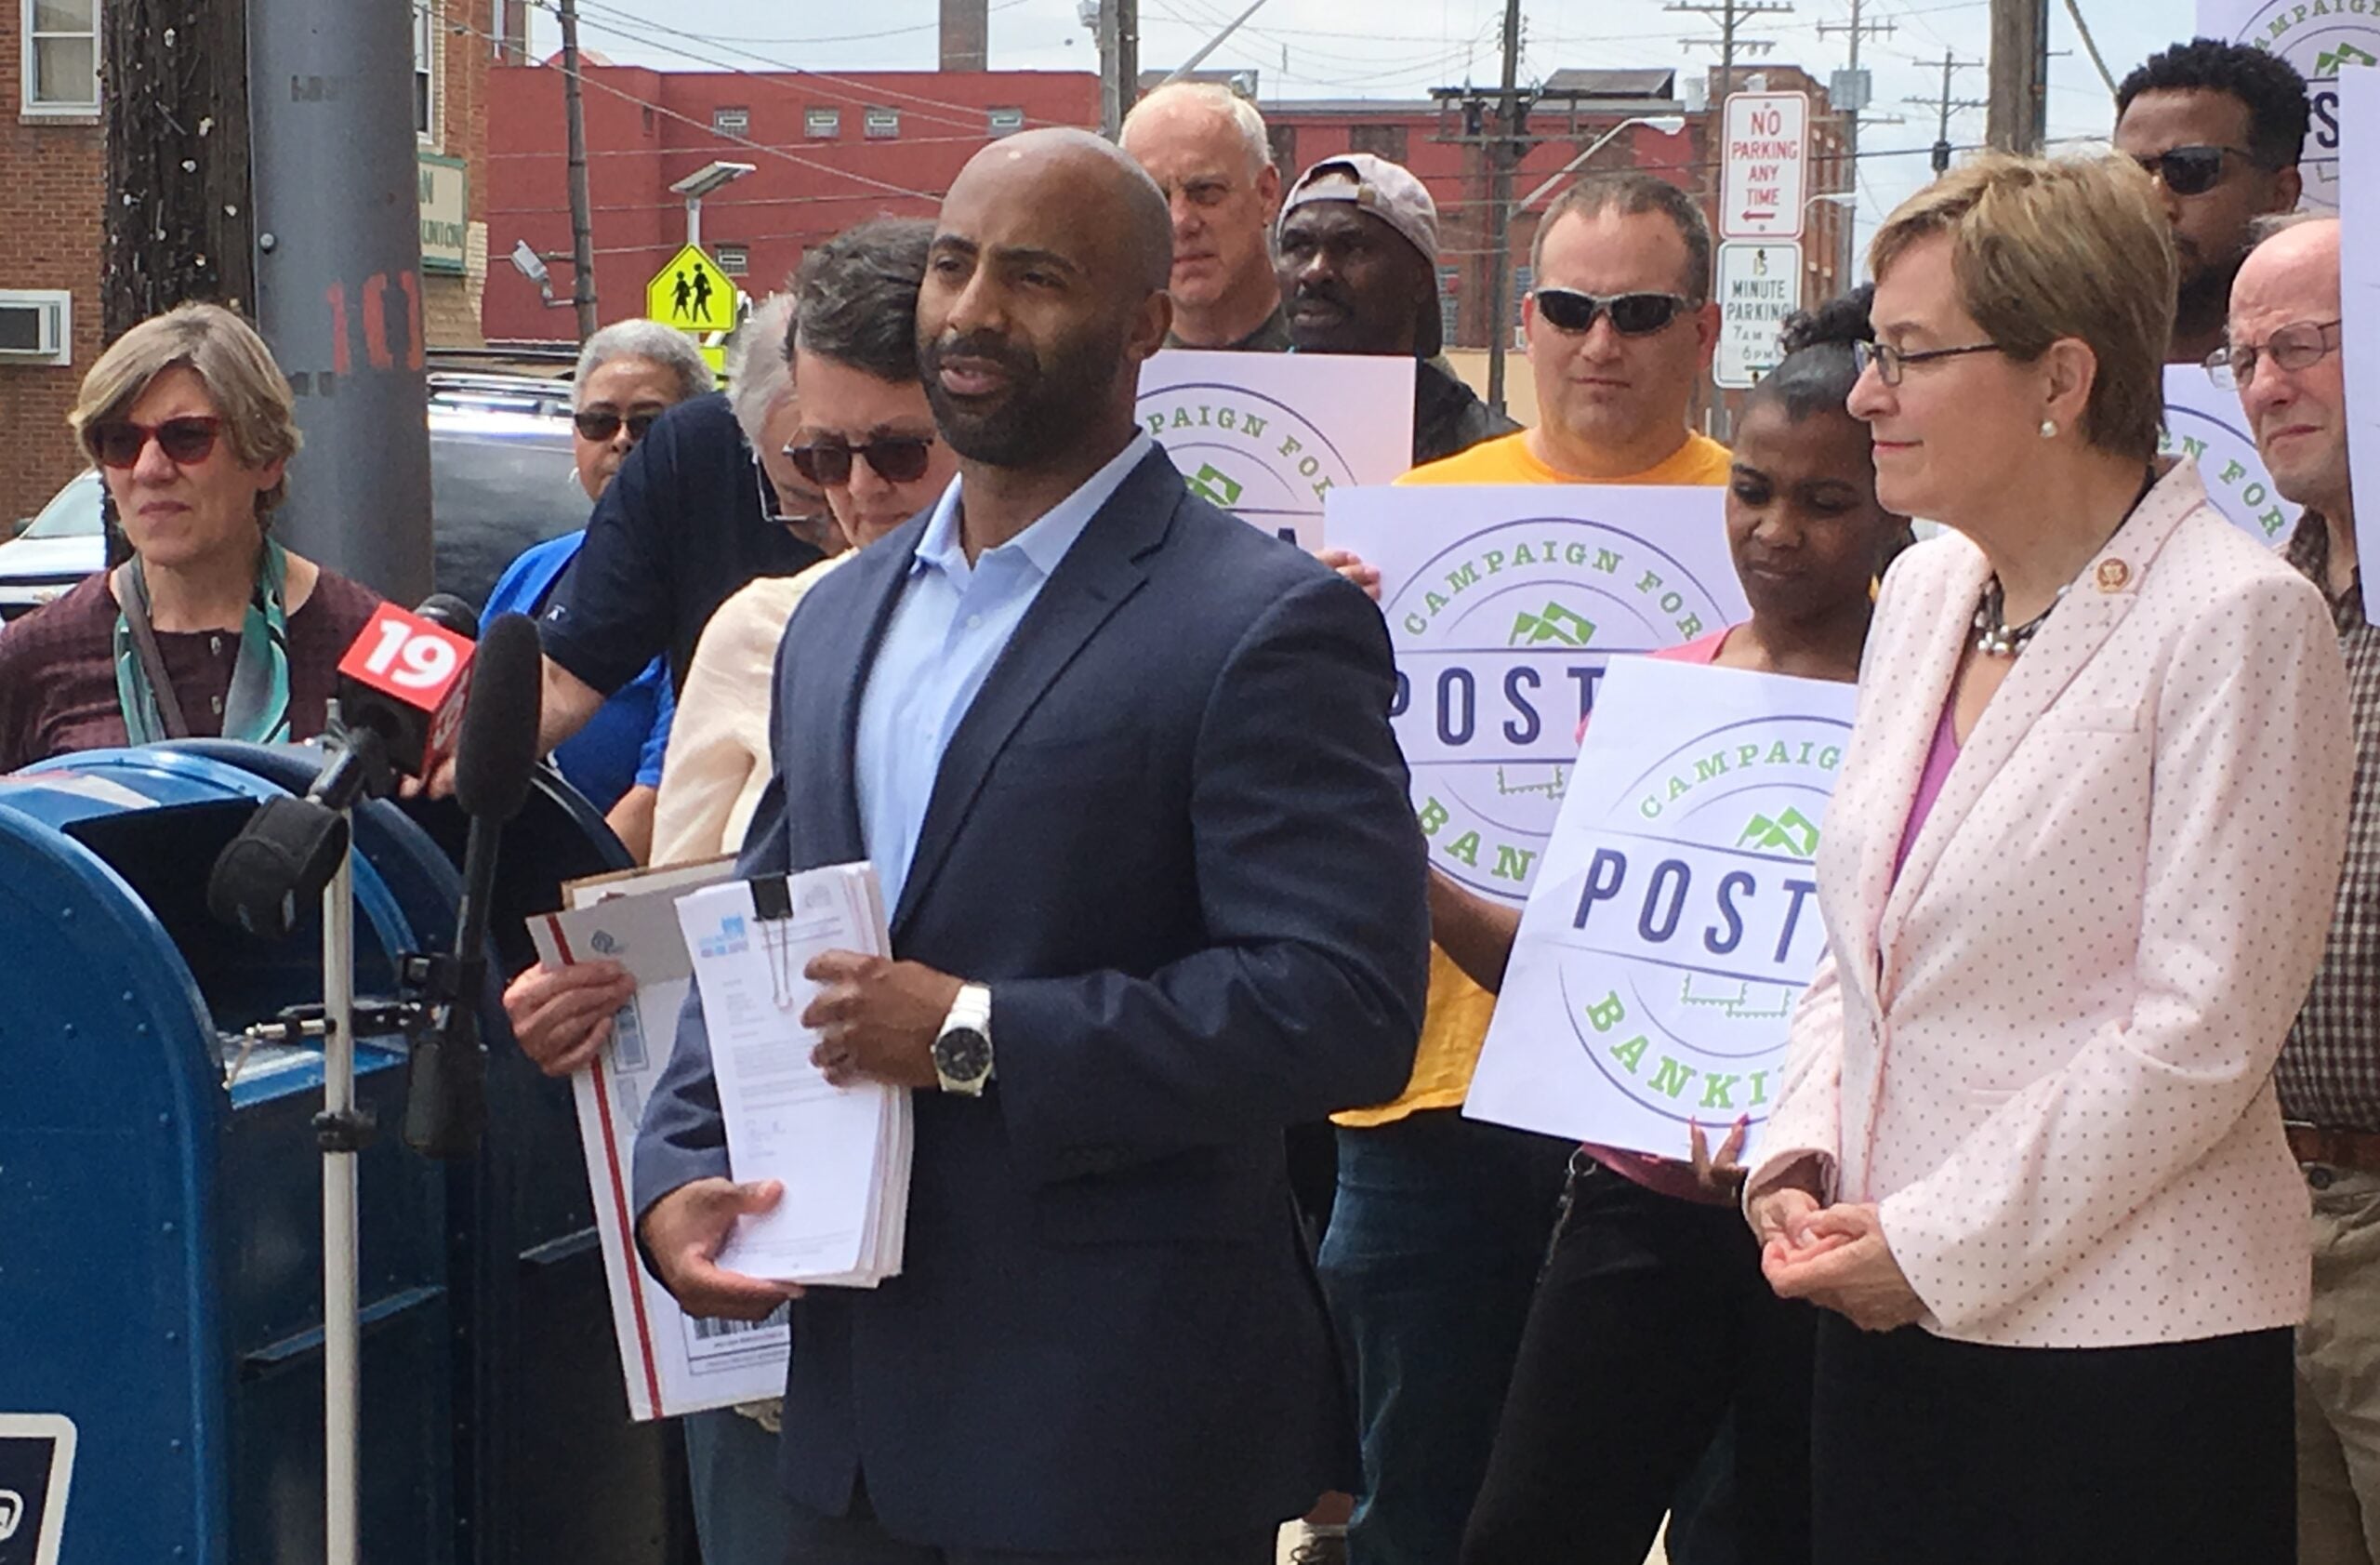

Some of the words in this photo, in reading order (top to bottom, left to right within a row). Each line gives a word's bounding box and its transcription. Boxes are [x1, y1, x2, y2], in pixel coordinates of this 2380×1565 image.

[1751, 111, 1781, 136] NO
[1731, 140, 1798, 160] PARKING
[1748, 165, 1780, 182] ANY
[1746, 188, 1780, 206] TIME
[1732, 279, 1786, 299] MINUTE
[1726, 302, 1792, 322] PARKING
[2218, 458, 2286, 538] FOR
[1403, 539, 1624, 635] CAMPAIGN
[1634, 570, 1703, 641] FOR
[364, 618, 458, 689] 19
[1572, 847, 1831, 965] POST
[1585, 989, 1785, 1109] BANKI
